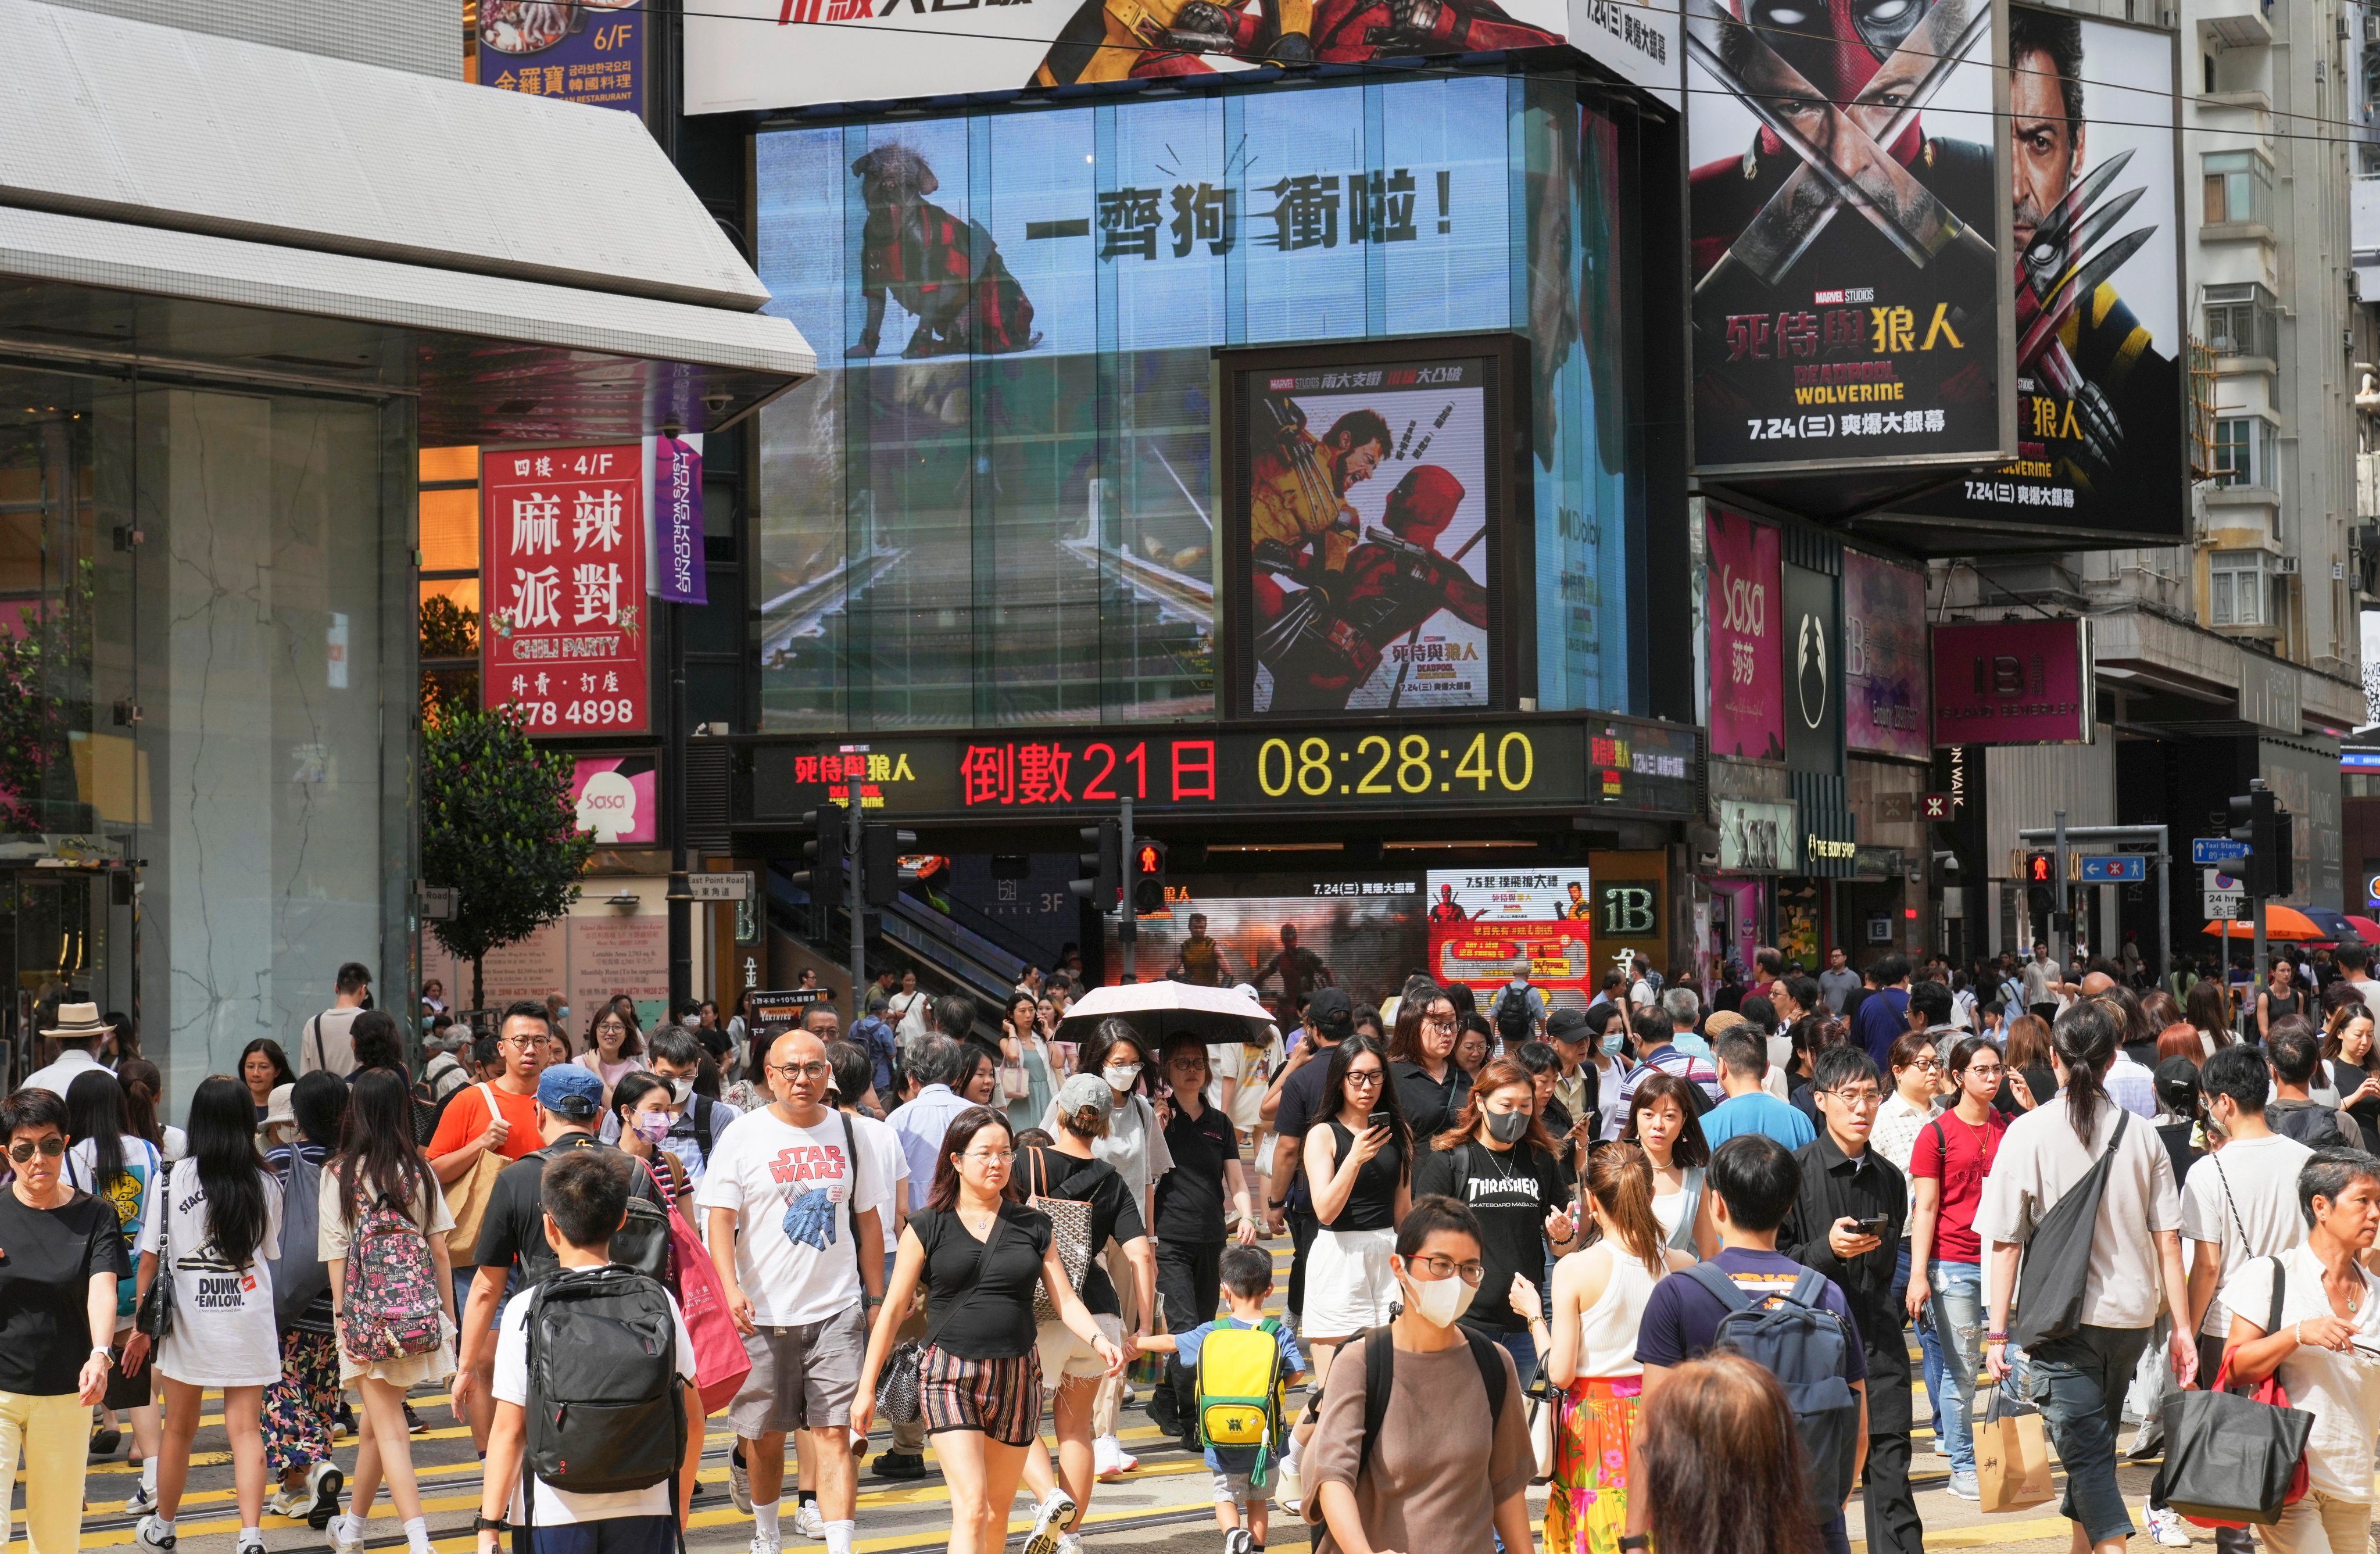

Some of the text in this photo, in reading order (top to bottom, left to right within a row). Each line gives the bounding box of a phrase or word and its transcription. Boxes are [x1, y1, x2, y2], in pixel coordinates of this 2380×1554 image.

[594, 24, 632, 51] 6/F
[568, 74, 632, 92] 韓國料理
[1814, 287, 1874, 305] MARVEL STUDIOS
[1726, 302, 1964, 361] 死侍與狼人
[1270, 377, 1319, 391] MARVEL STUDIOS
[1794, 361, 1898, 385] DEADPOOL
[2017, 378, 2034, 391] STUDIOS
[1795, 382, 1904, 405] WOLVERINE
[1748, 409, 1945, 439] 7.24(三) 爽爆大銀幕
[574, 453, 613, 475] 4/F
[1964, 481, 2074, 508] 7.24(三) 爽爆大銀幕
[511, 489, 623, 556] 麻辣
[672, 452, 682, 592] ASIA'S WORLD CITY
[680, 453, 691, 593] HONG KONG
[1573, 510, 1602, 547] Dolby
[511, 563, 623, 629] 派對
[513, 636, 620, 660] CHILI PARTY
[1392, 642, 1479, 663] 死侍與狼人
[1733, 639, 1754, 686] 莎莎
[565, 699, 633, 725] 4898
[1939, 702, 2078, 719] ISLAND BEVERLEY
[795, 753, 915, 783] 死侍與狼人
[1258, 731, 1533, 796] 08:28:40
[1817, 840, 1855, 858] THE BODY SHOP
[2209, 851, 2237, 860] 的士站
[2323, 829, 2339, 862] STYLE
[427, 891, 447, 900] Road
[702, 887, 729, 897] 東角道
[1314, 882, 1359, 896] 7.24(三)
[1040, 893, 1063, 912] 3F
[1876, 924, 1882, 935] E
[768, 1145, 846, 1168] STAR
[770, 1162, 846, 1184] WARS
[1468, 1177, 1540, 1202] THRASHER
[199, 1278, 241, 1295] DUNK
